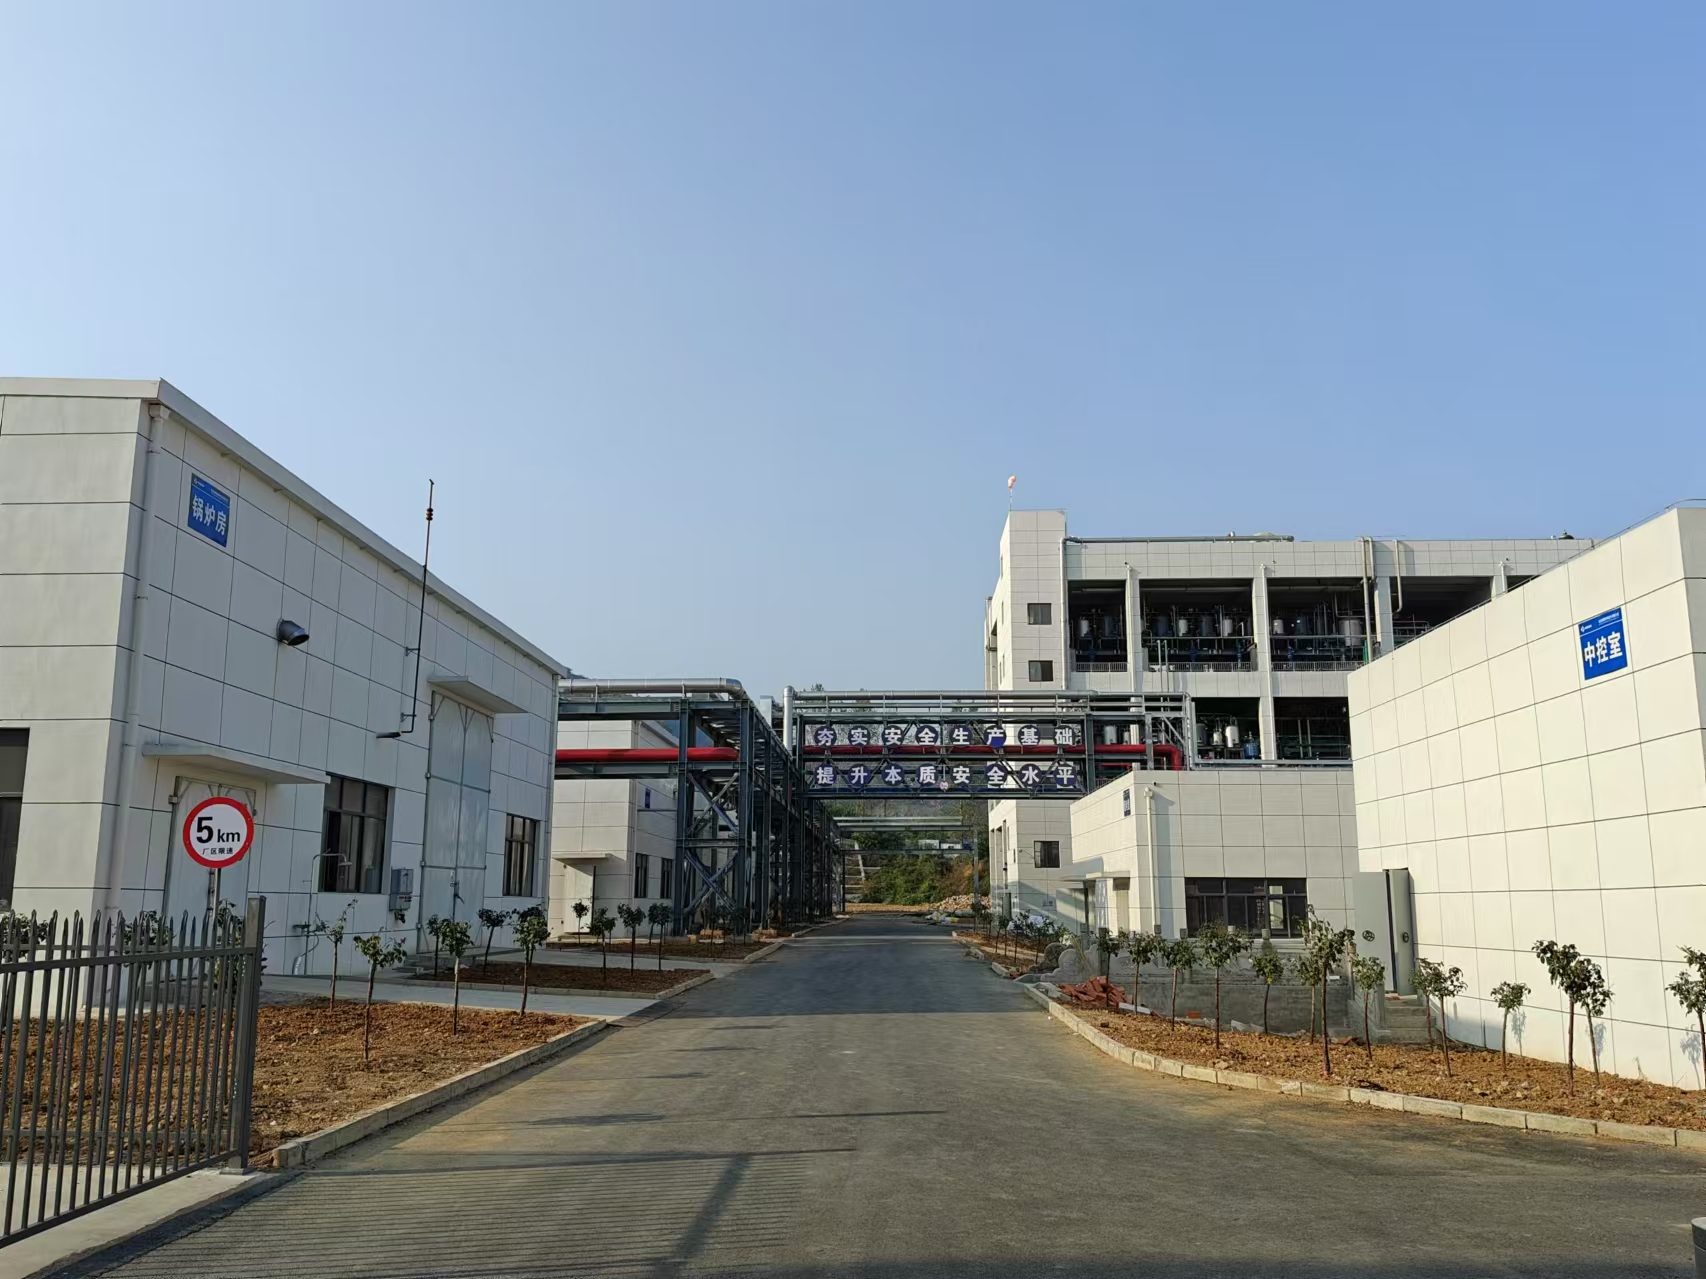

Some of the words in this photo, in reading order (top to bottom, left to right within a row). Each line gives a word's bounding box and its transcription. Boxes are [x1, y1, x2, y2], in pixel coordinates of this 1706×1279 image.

[192, 494, 227, 535] 锅炉房
[1584, 631, 1623, 667] 中控室
[816, 726, 1074, 747] 夯实安全生产基础
[816, 765, 1076, 785] 提升本质安全水平
[202, 847, 233, 855] 厂区限速
